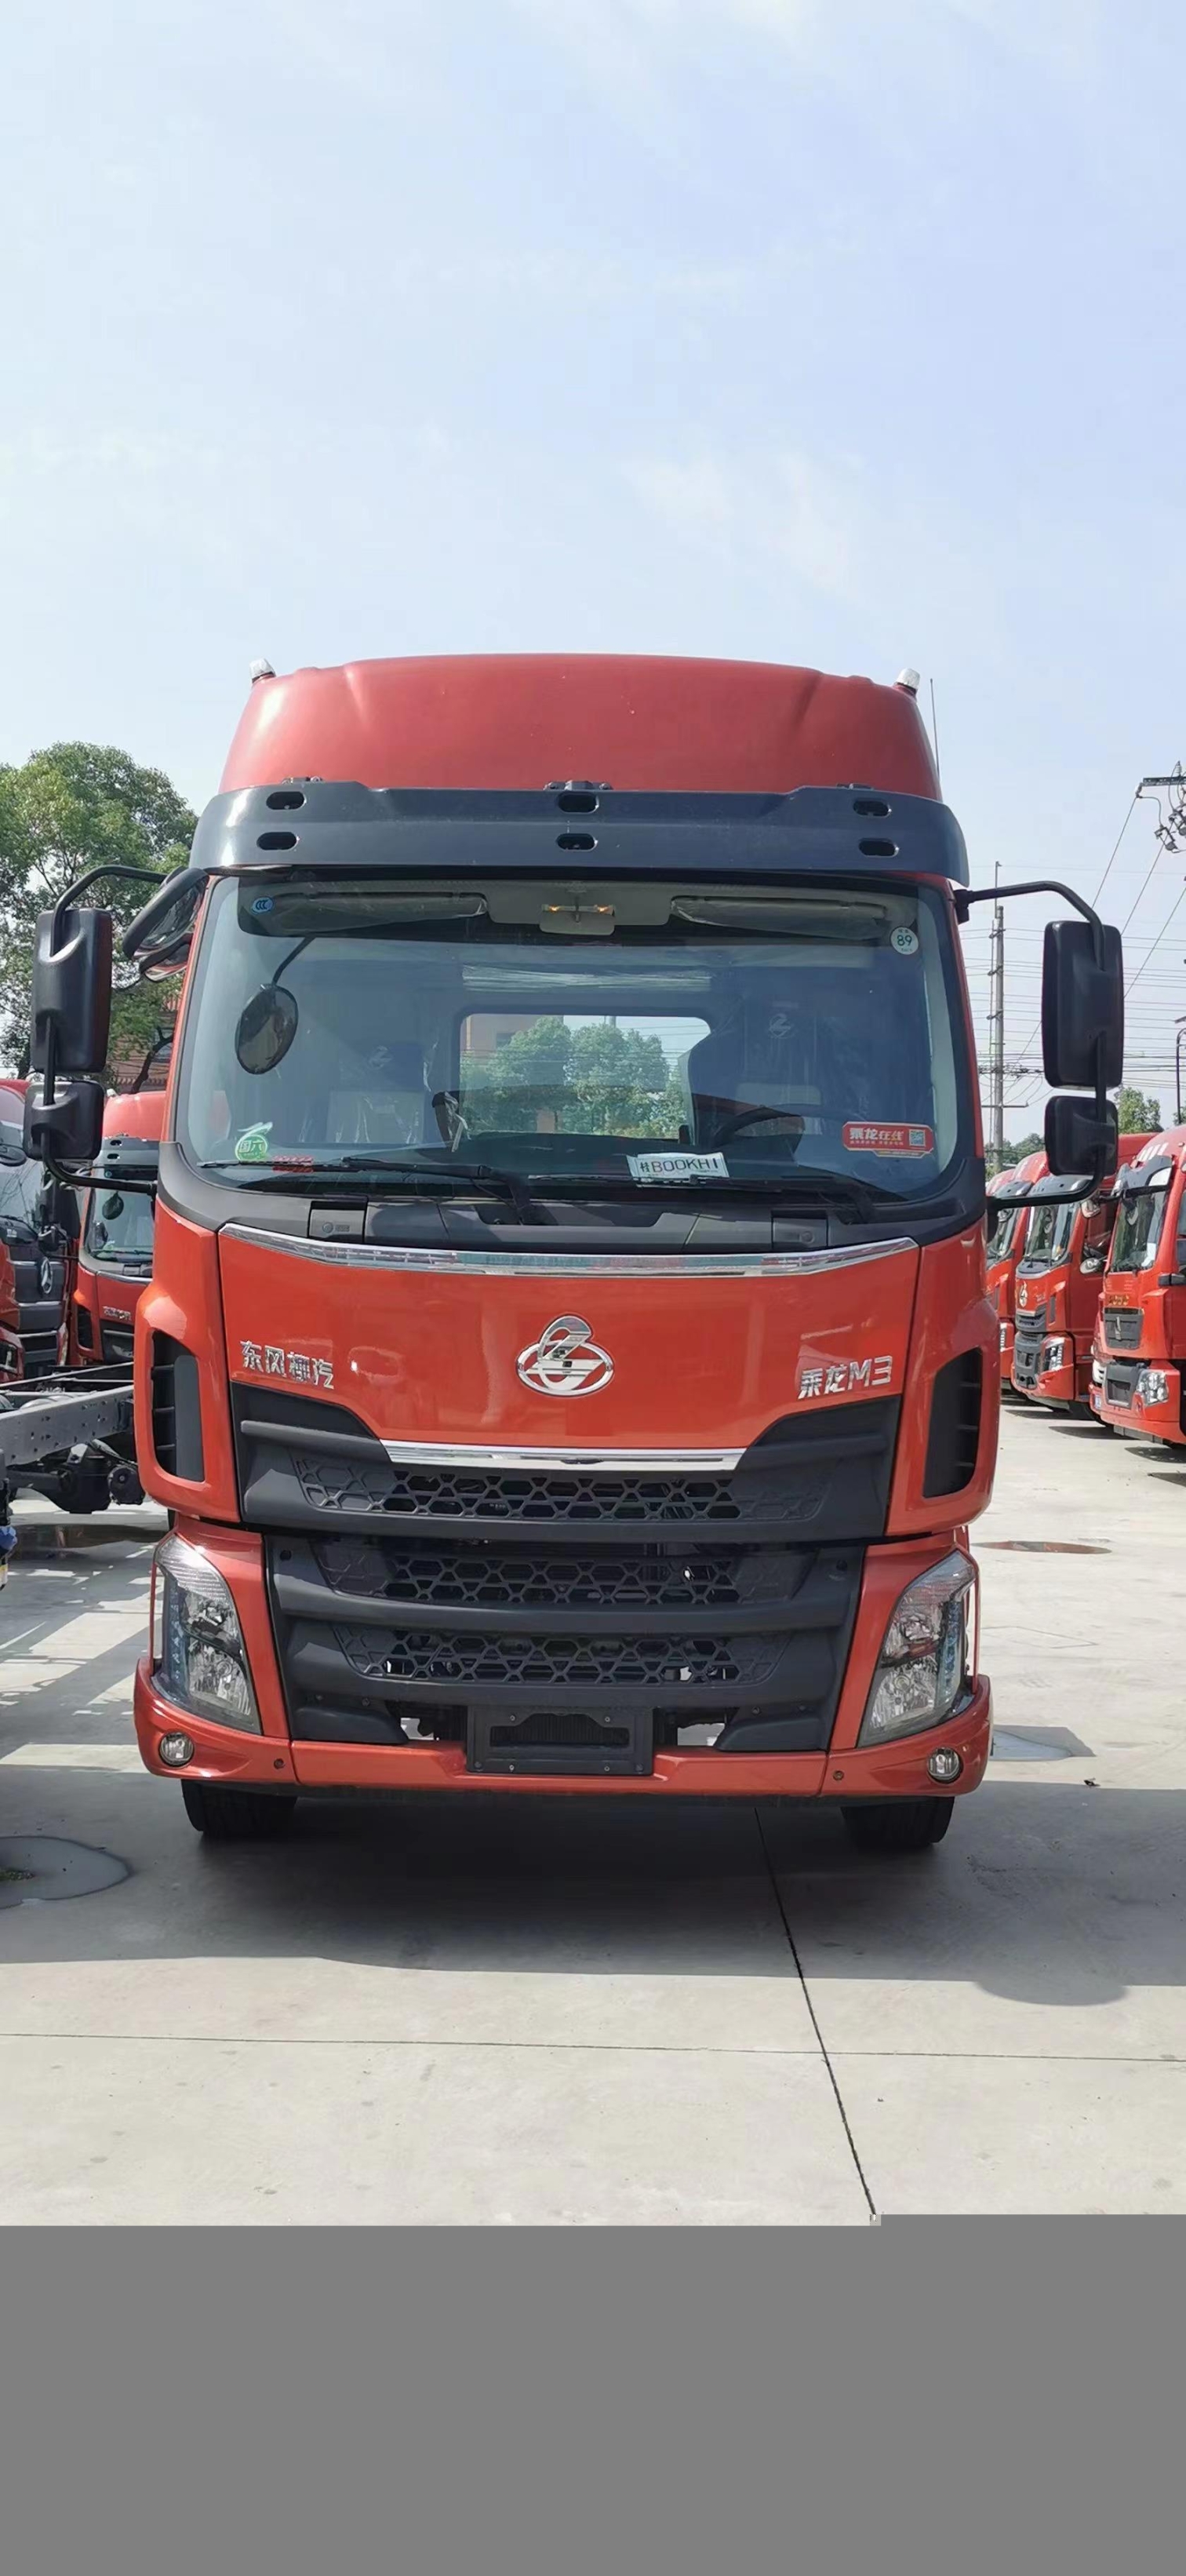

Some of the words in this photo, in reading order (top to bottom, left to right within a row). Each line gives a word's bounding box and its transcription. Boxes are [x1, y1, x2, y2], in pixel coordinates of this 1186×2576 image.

[897, 935, 912, 946] 89
[239, 1339, 335, 1390] 东风柳汽
[797, 1354, 893, 1400] 乘龙M3
